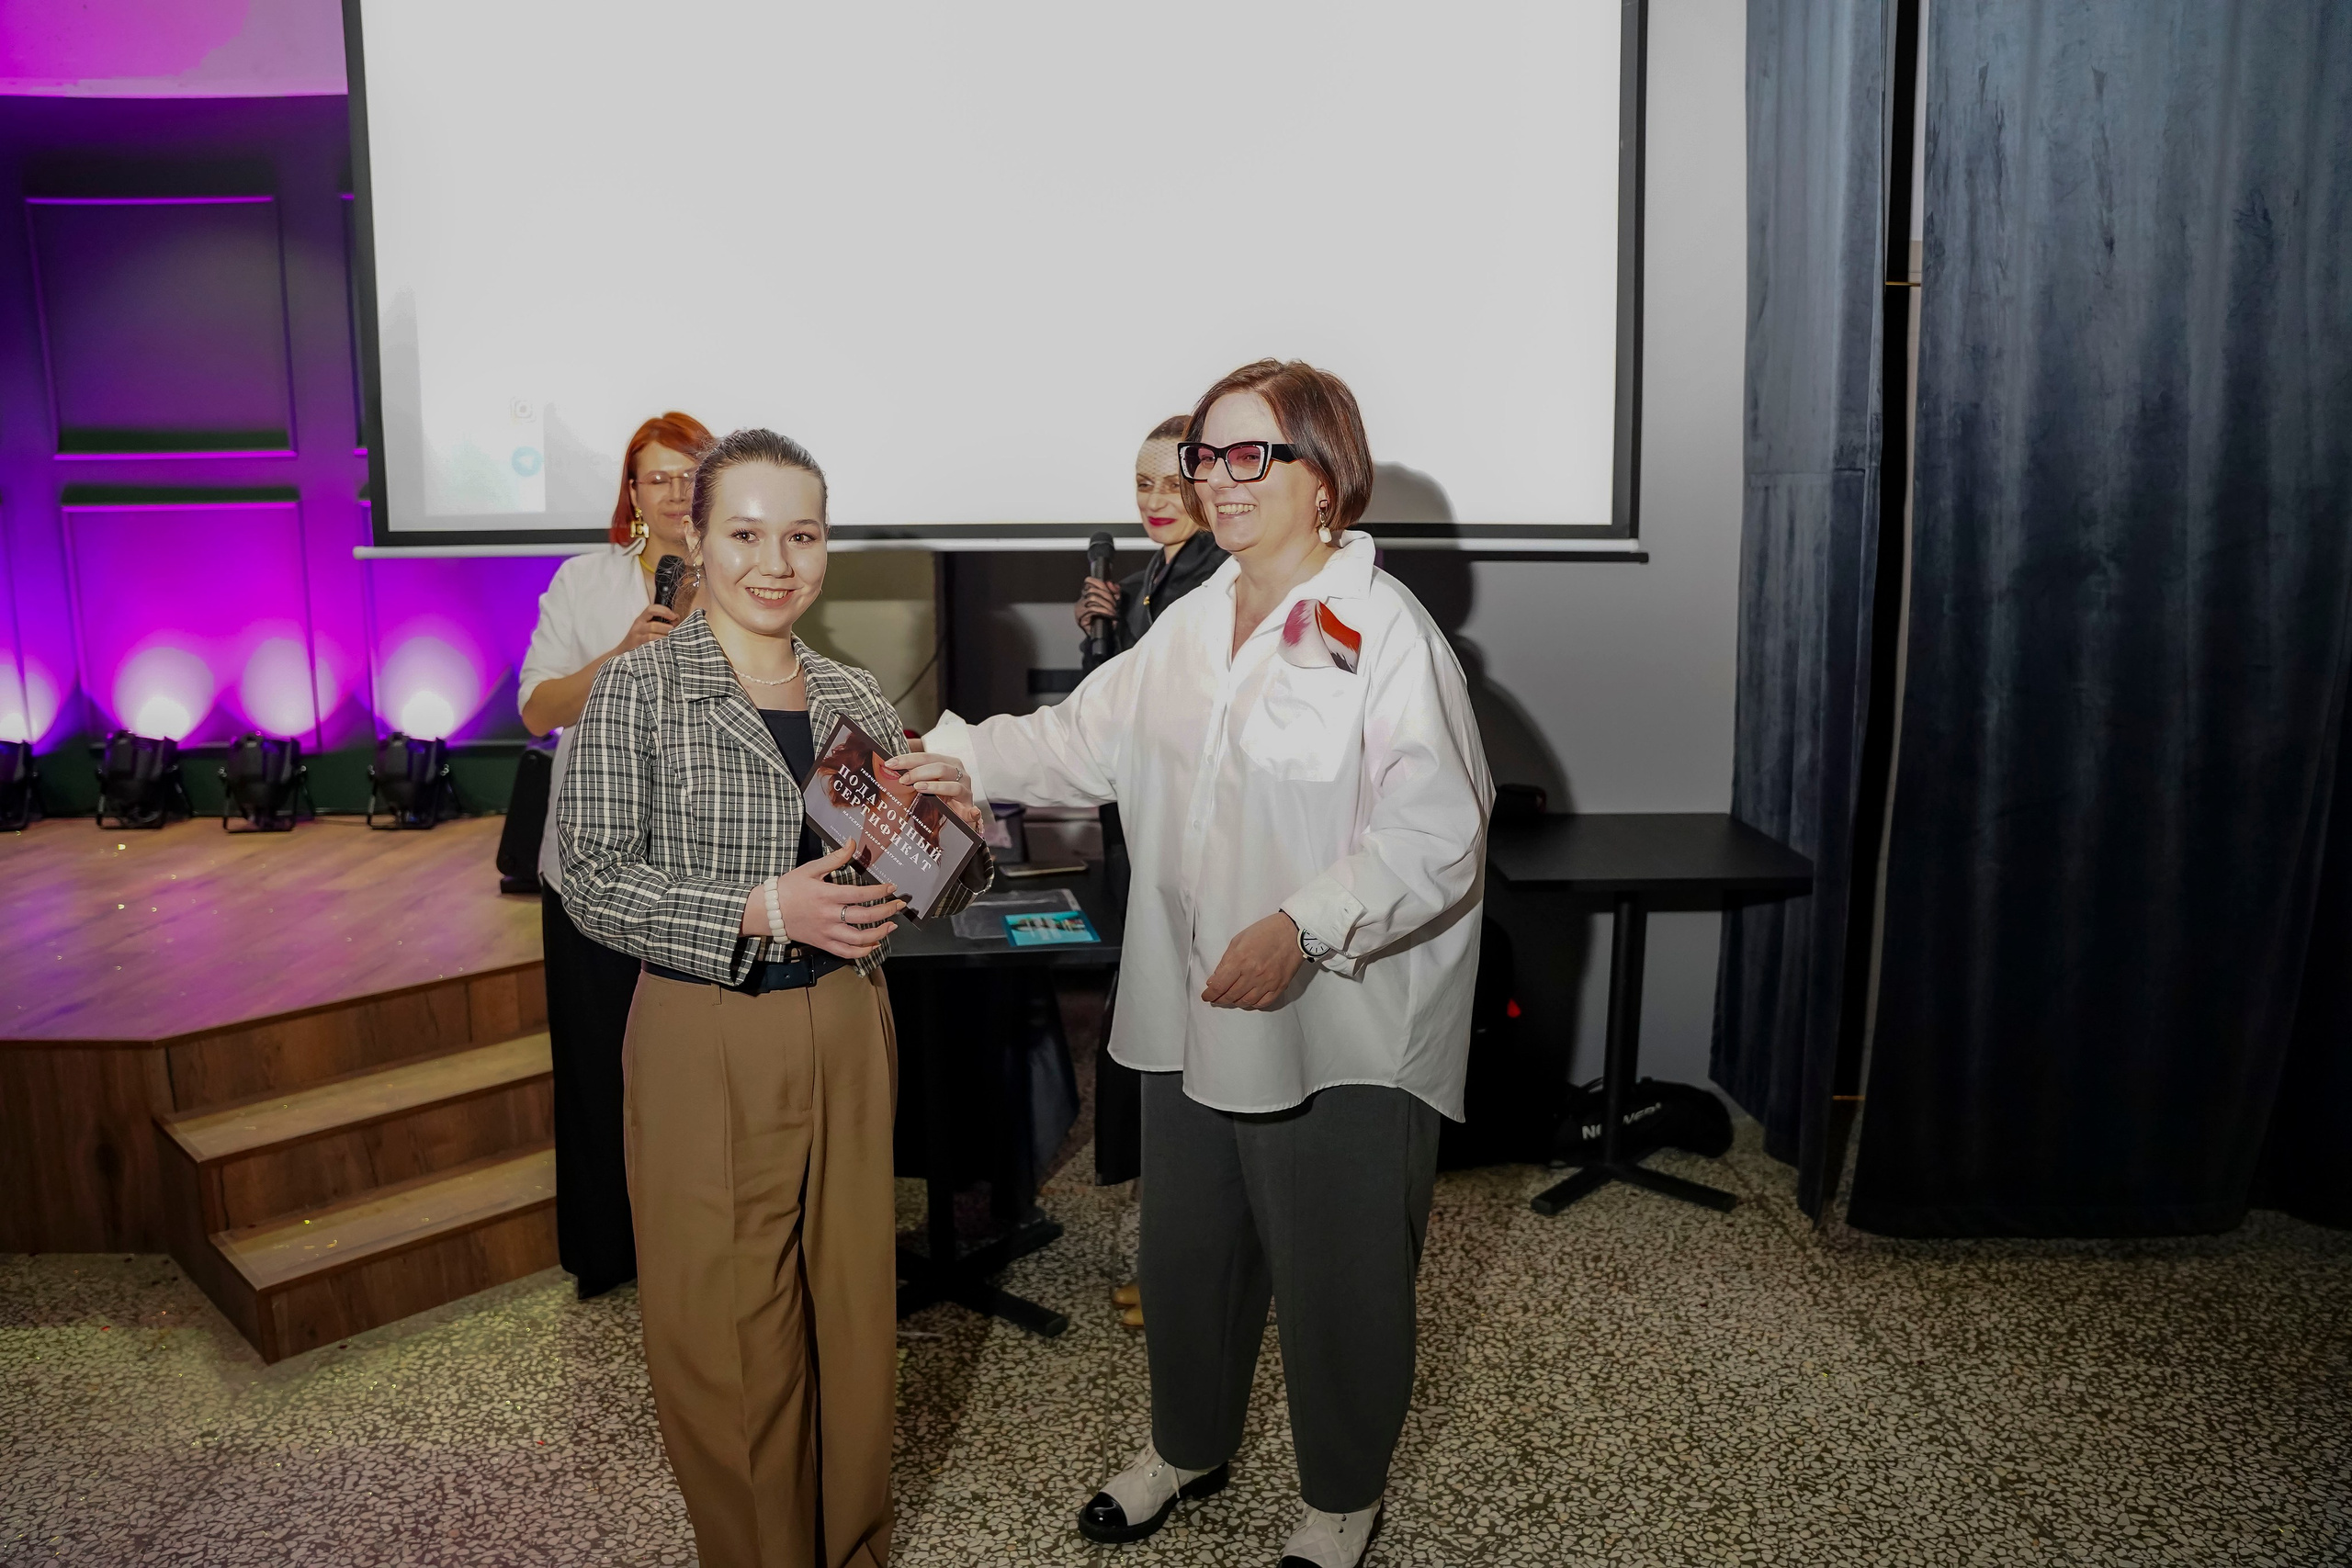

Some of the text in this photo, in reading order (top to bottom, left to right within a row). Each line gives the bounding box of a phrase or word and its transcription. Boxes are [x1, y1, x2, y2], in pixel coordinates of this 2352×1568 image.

[838, 764, 943, 863] ПОДАРОЧНЫЙ
[860, 768, 887, 793] ТВОРЧЕСКИЙ
[886, 791, 902, 807] ПРОЕКТ
[833, 780, 932, 872] СЕРТИФИКАТ
[848, 816, 864, 830] УСЛУГУ
